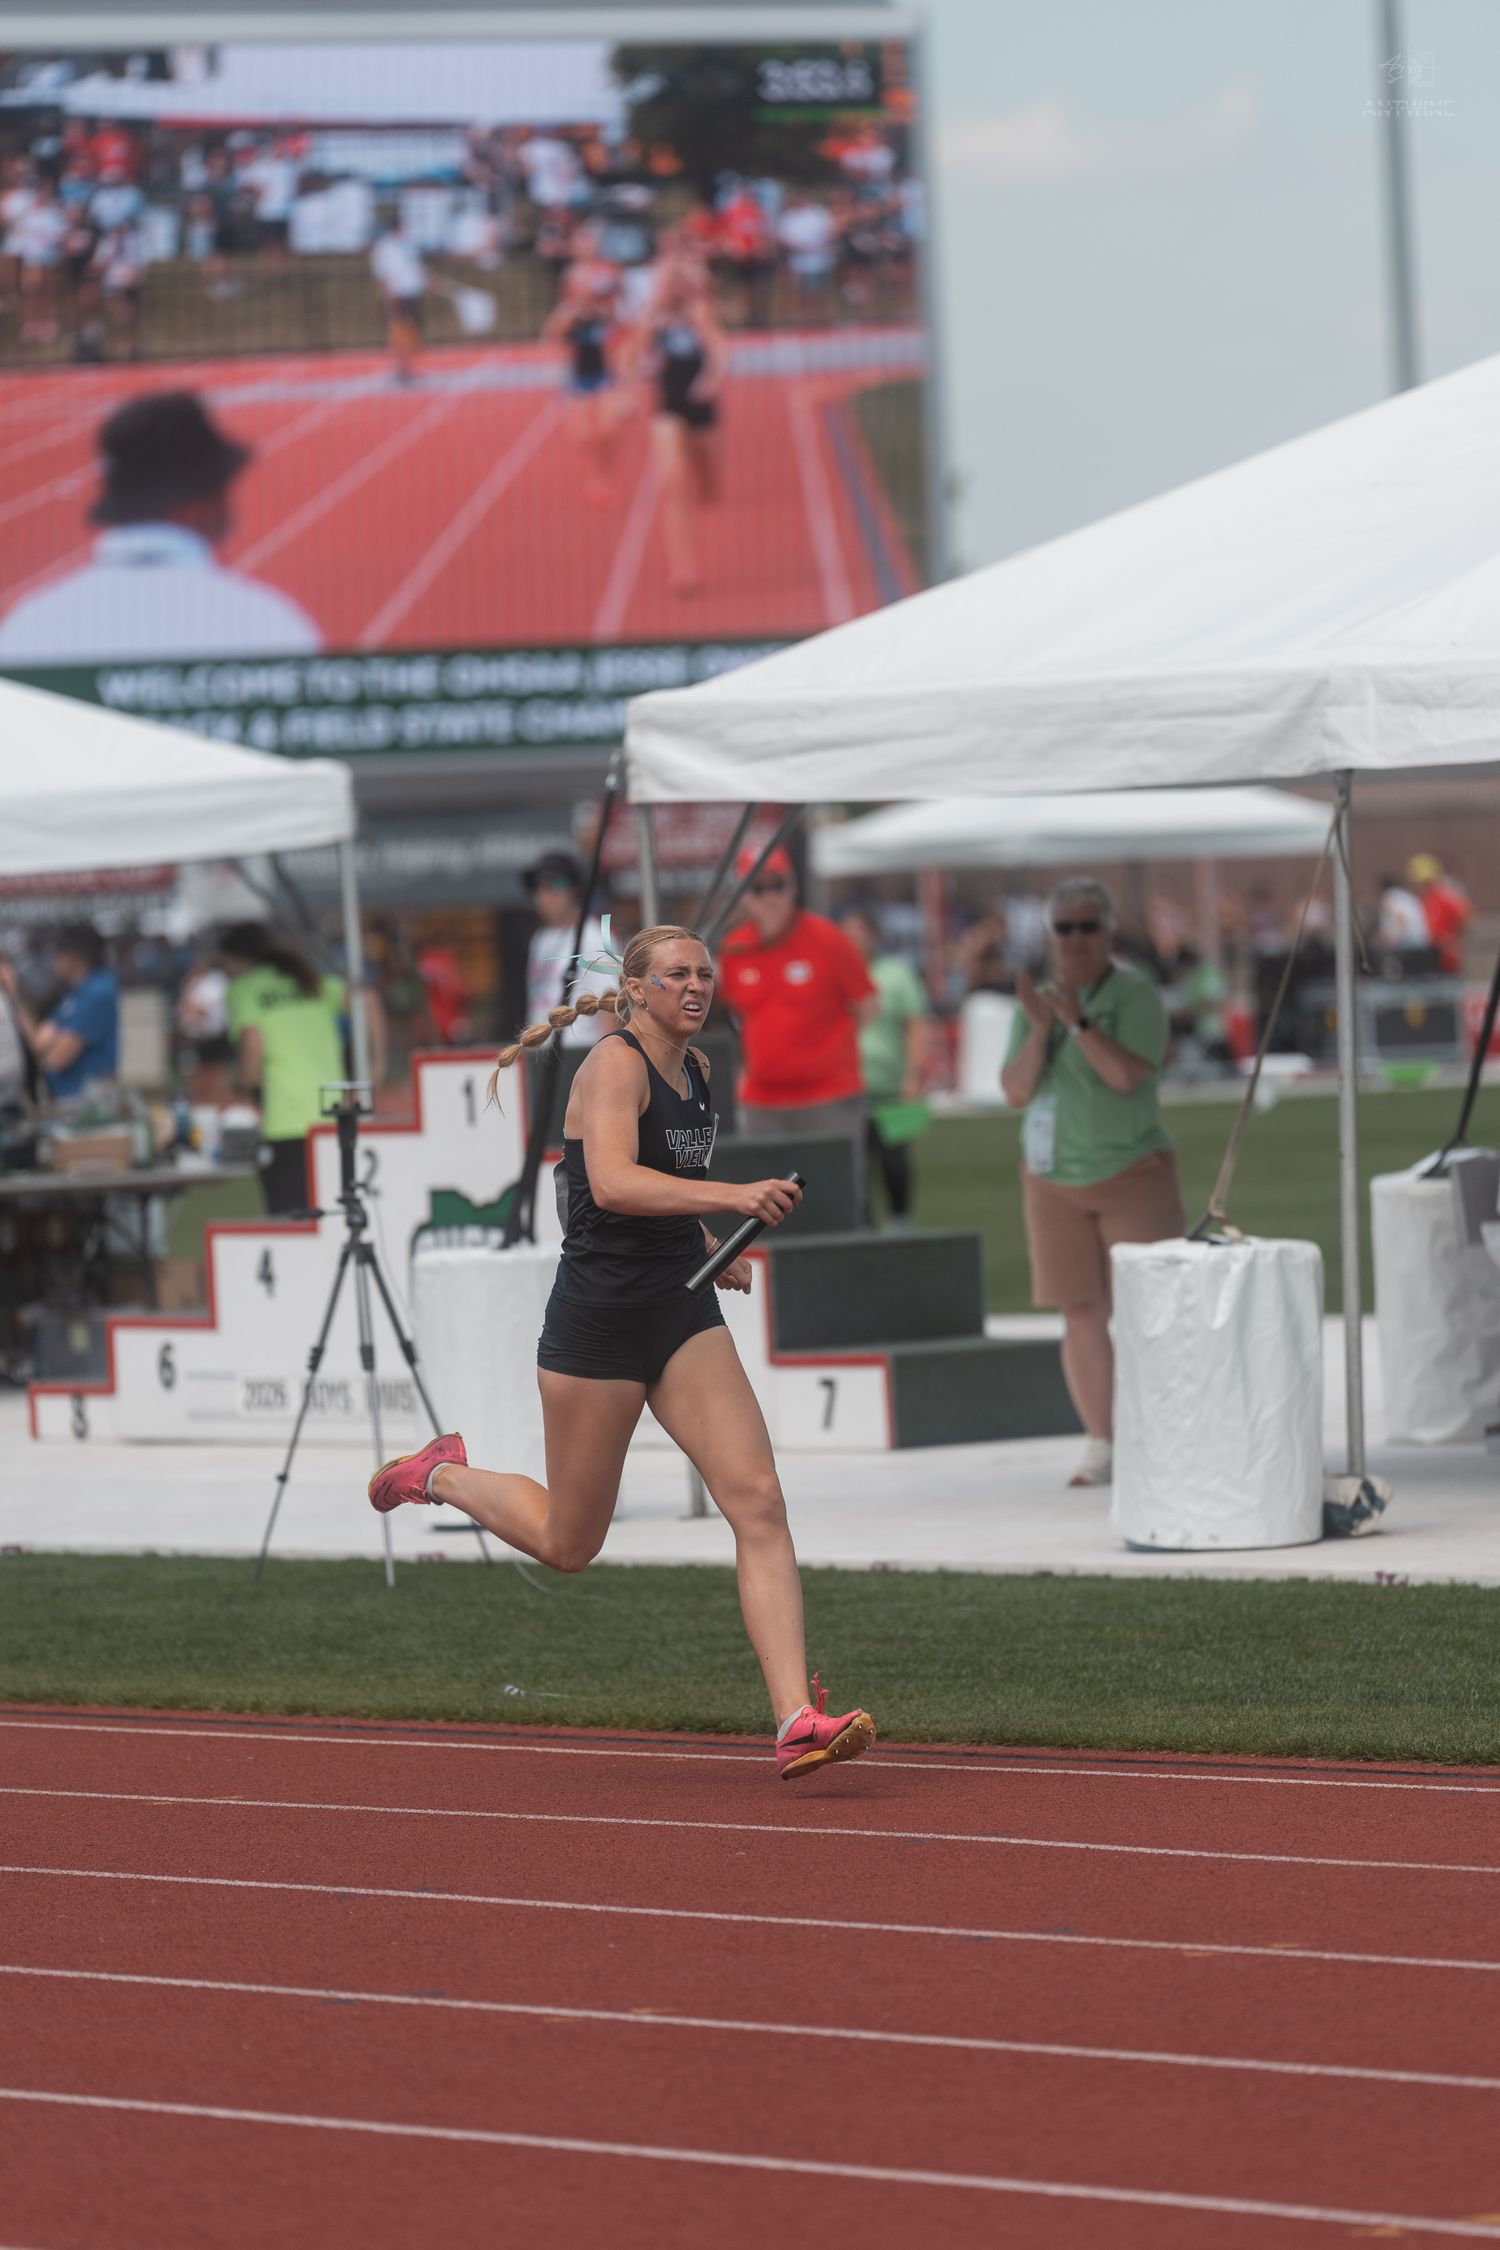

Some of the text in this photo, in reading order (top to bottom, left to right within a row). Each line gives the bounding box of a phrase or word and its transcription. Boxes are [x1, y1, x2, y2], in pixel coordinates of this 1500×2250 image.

[97, 662, 299, 706] WELCOME
[304, 658, 361, 700] TO
[364, 655, 440, 699] THE
[462, 1076, 476, 1129] 1
[665, 1127, 712, 1149] VALLE
[360, 1148, 381, 1198] 2
[257, 1247, 274, 1299] 4
[158, 1341, 176, 1391] 6
[818, 1377, 837, 1432] 7
